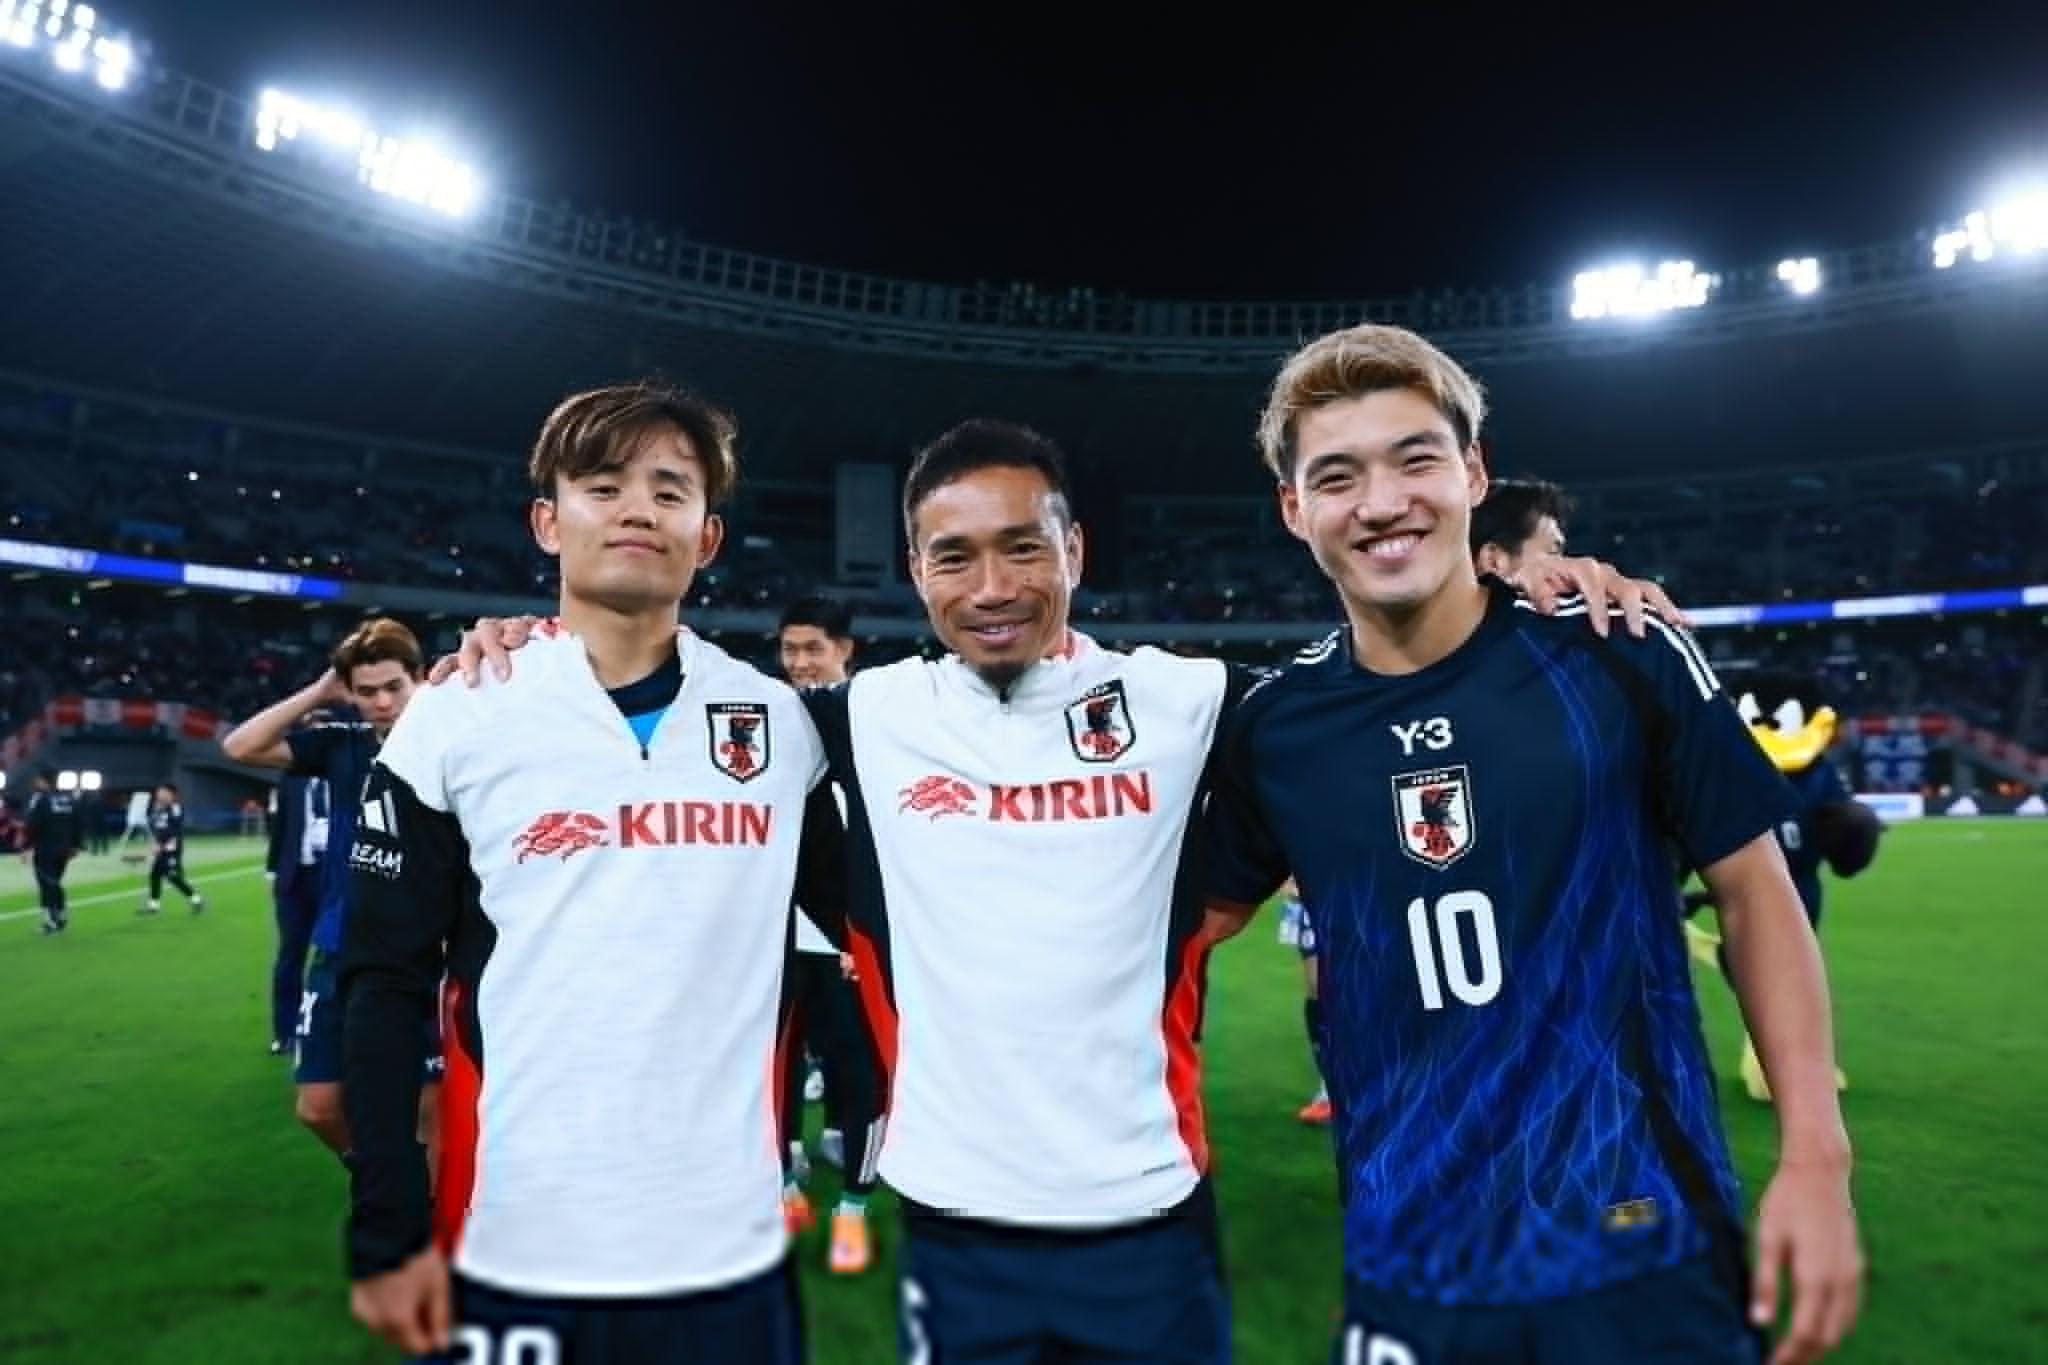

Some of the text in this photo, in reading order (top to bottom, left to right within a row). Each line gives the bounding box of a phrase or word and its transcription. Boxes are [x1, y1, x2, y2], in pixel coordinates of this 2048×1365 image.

[1391, 716, 1454, 755] Y-3
[989, 771, 1151, 822] KIRIN
[619, 801, 772, 848] KIRIN
[1408, 890, 1503, 1009] 10
